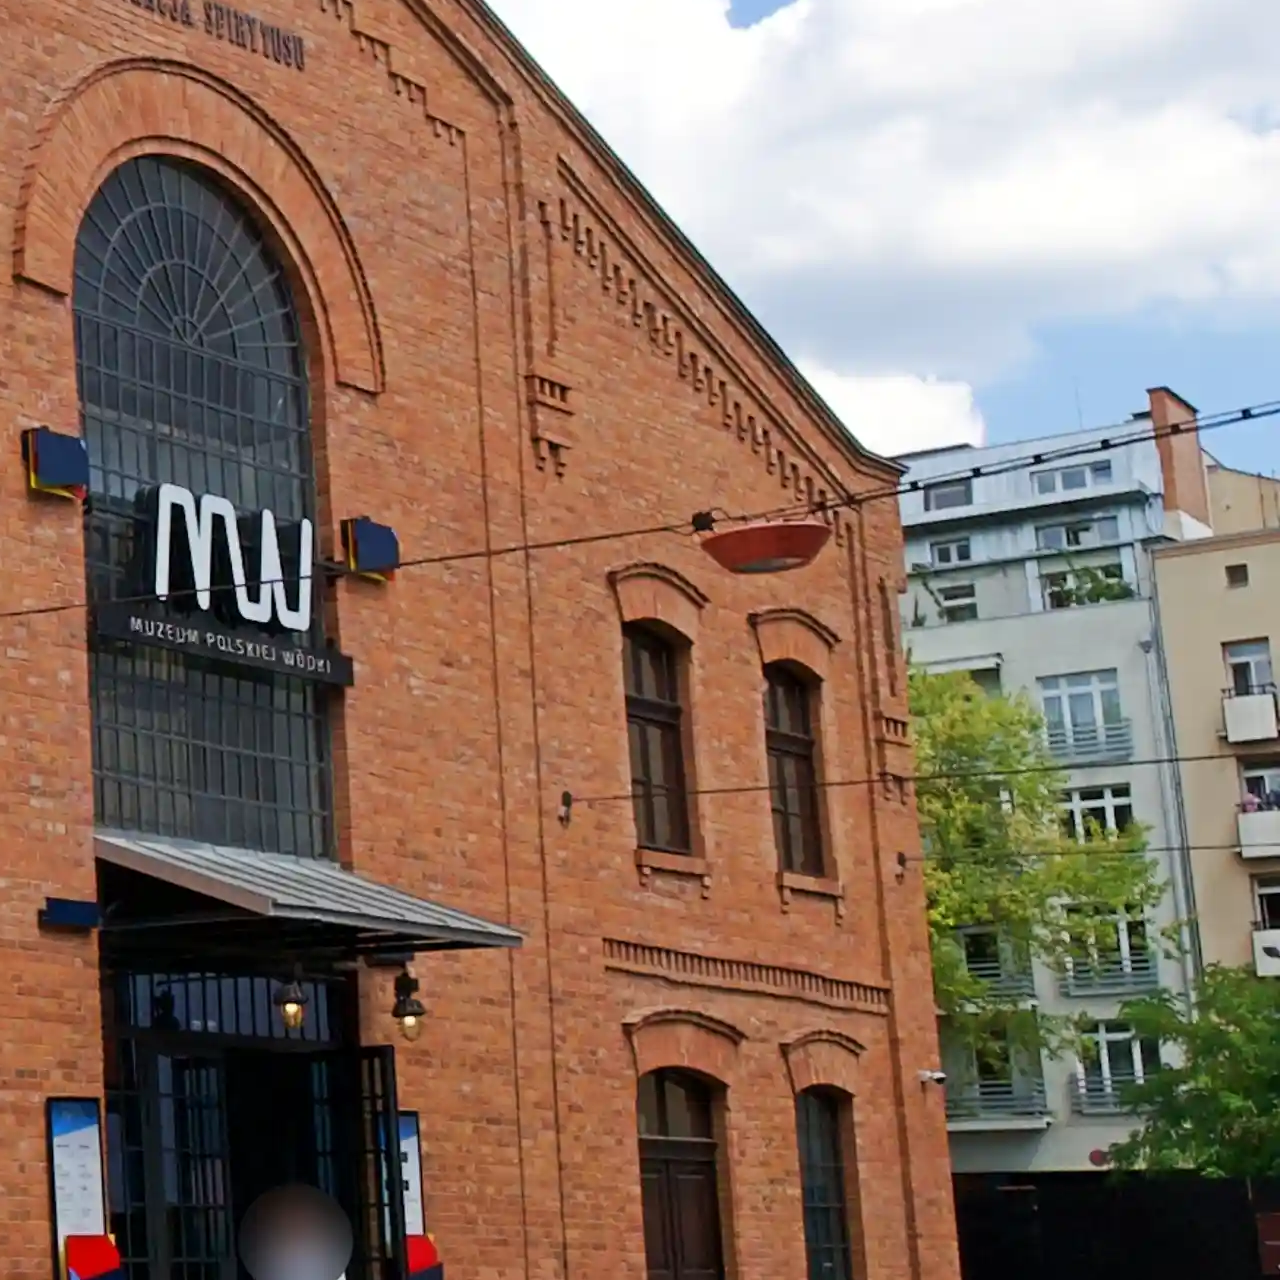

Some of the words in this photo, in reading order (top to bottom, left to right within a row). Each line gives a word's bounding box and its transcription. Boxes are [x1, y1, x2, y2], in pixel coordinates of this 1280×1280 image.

[203, 0, 304, 71] SPIRYTUSU
[130, 616, 200, 645] MUZEUM
[206, 632, 276, 661] POLSKIEJ
[281, 648, 332, 674] WÓDKI
